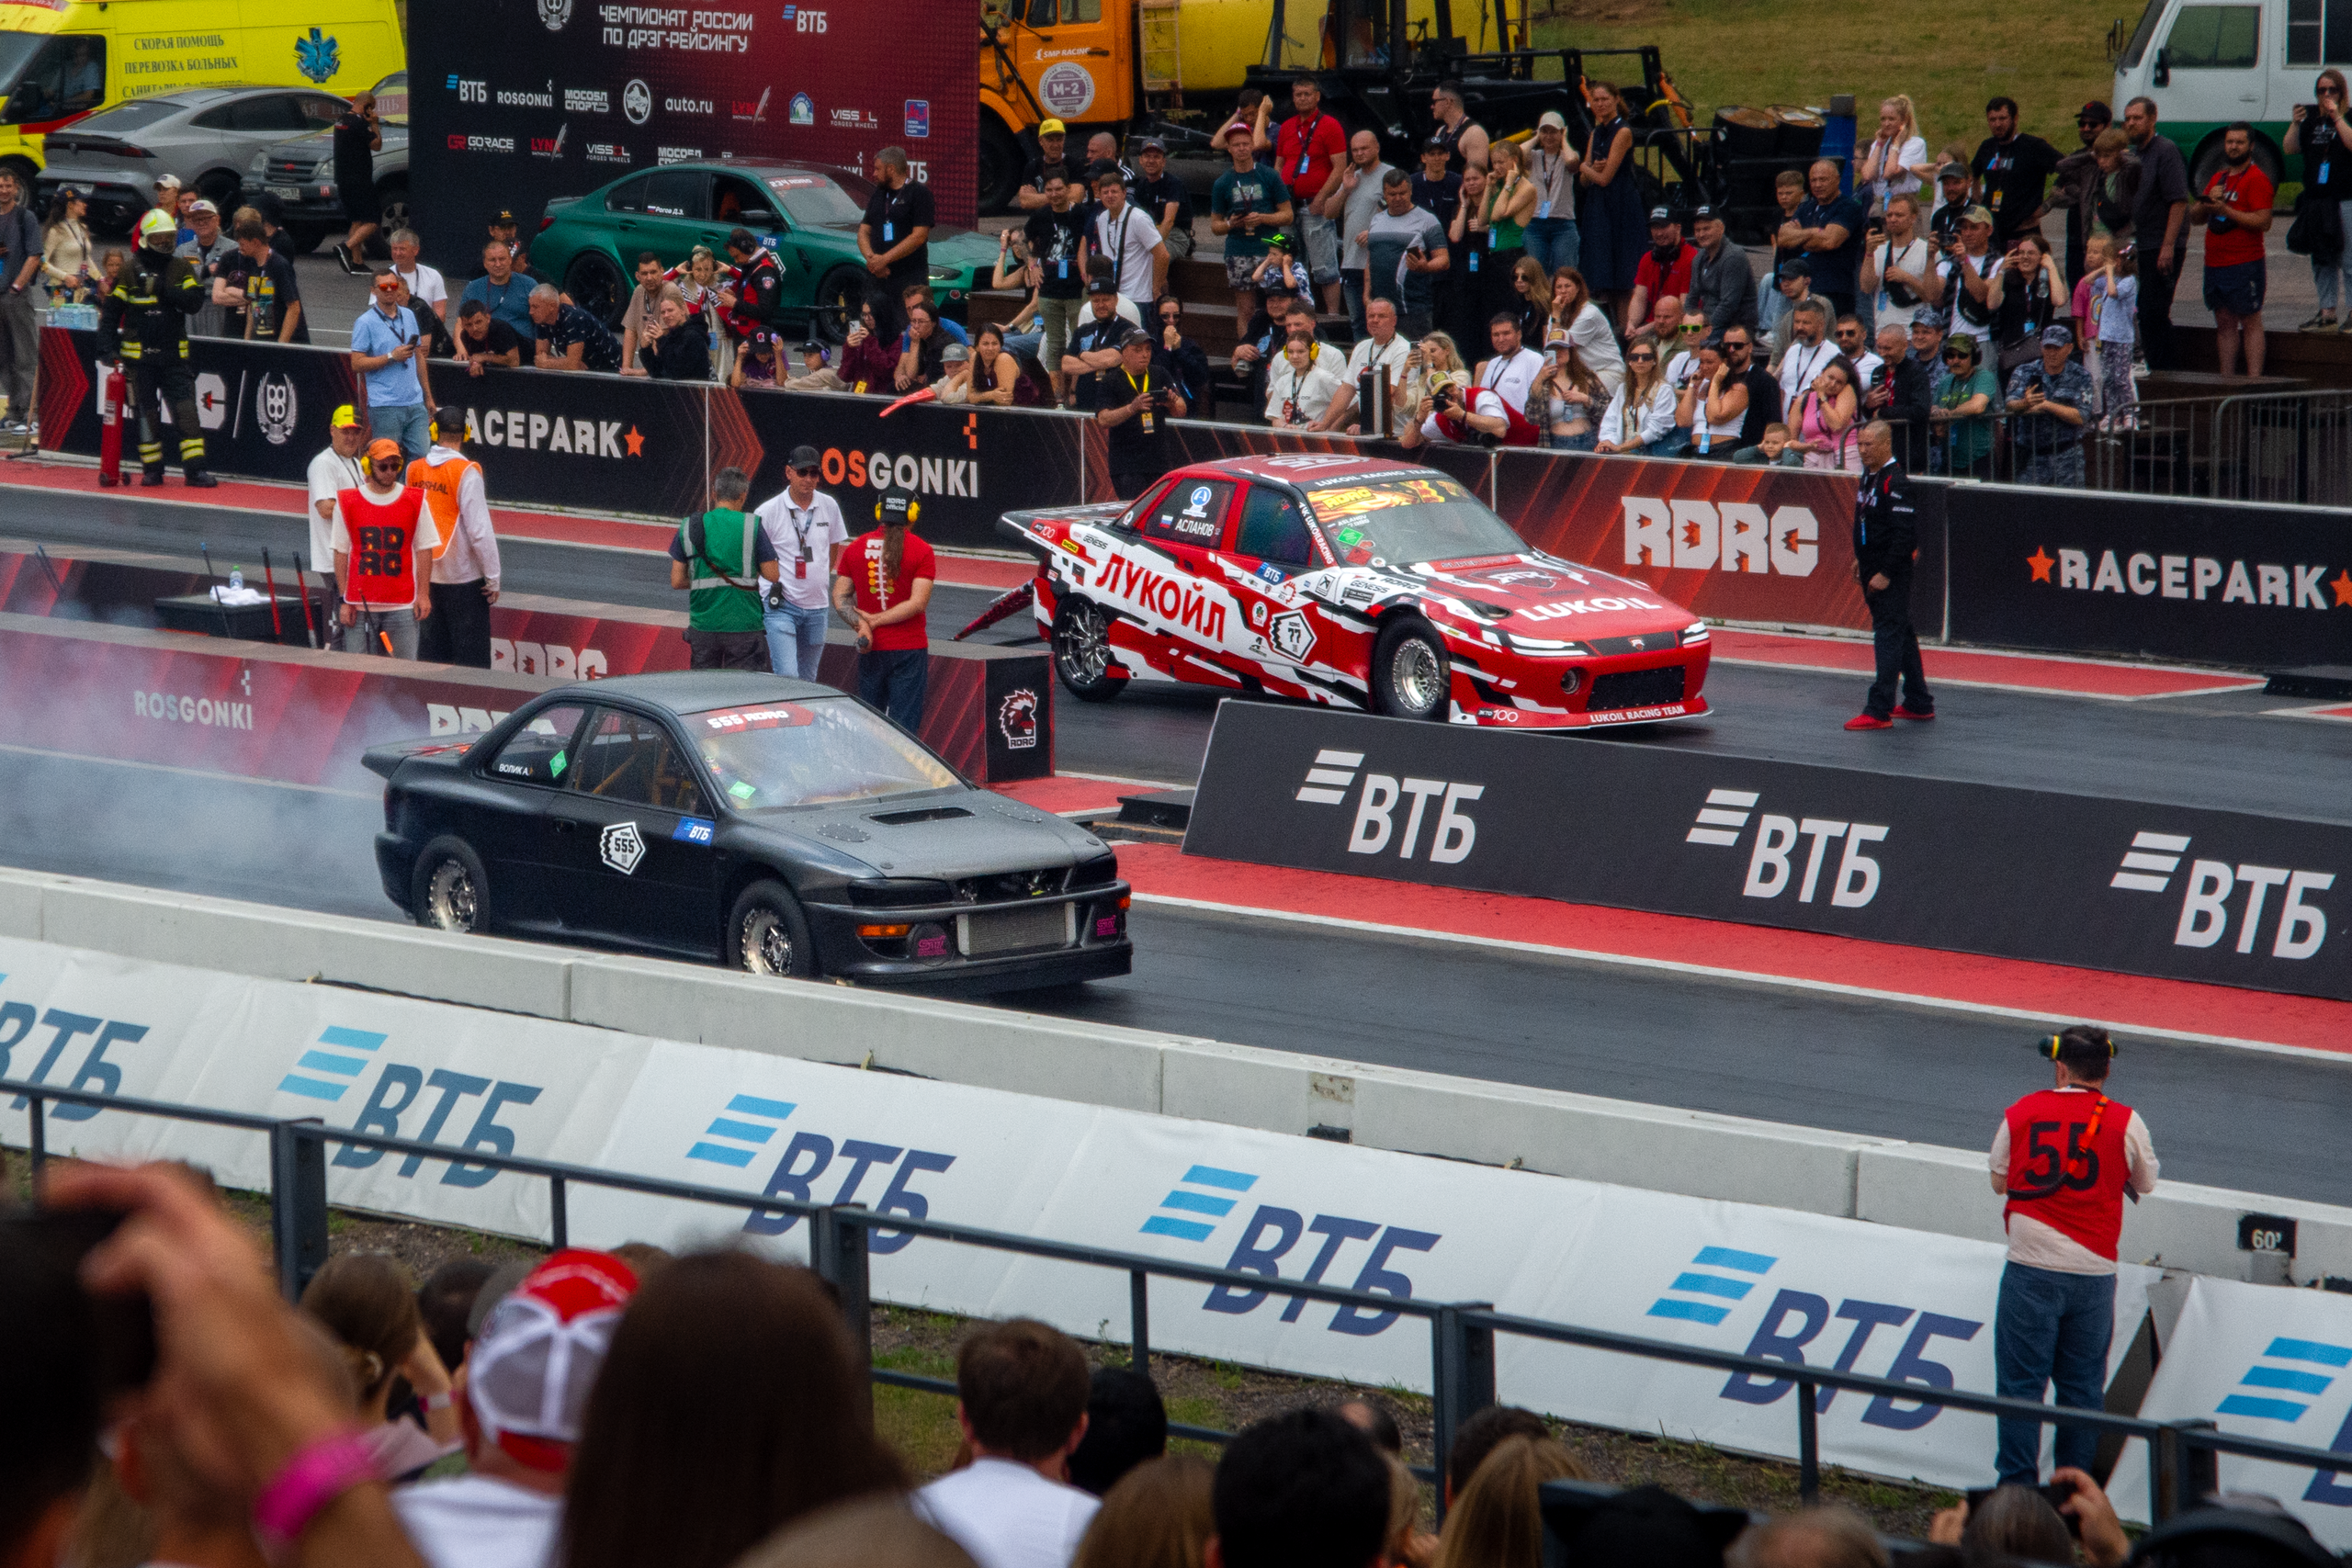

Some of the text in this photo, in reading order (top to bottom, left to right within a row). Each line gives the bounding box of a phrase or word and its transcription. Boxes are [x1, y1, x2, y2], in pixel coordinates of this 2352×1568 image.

[599, 6, 753, 30] ЧЕМПИОНАТ РОССИИ
[797, 10, 827, 33] ВТБ
[133, 34, 225, 51] СКОРАЯ ПОМОЩЬ
[604, 28, 748, 52] ПО ДРЭГ-РЕЙСИНГУ
[1043, 50, 1061, 58] SMP
[124, 56, 238, 74] ПЕРЕВОЗКА БОЛЬНЫХ
[459, 79, 487, 102] ВТБ
[497, 91, 552, 107] ROSGONKI
[1052, 82, 1080, 96] M-2
[665, 96, 713, 114] auto.ru
[830, 108, 878, 122] VISSOL
[586, 143, 630, 156] VISSOL
[907, 160, 928, 184] ТБ
[763, 237, 776, 247] ВТБ
[436, 406, 622, 458] ACEPARK
[821, 447, 978, 498] OSGONKI
[1315, 476, 1361, 488] LUKOIL
[1175, 518, 1215, 536] АСЛАНОВ
[1622, 496, 1818, 577] RDRC
[1082, 535, 1109, 550] GENESIS
[1263, 566, 1282, 583] ВТБ
[2059, 547, 2328, 610] RACEPARK
[1095, 552, 1227, 643] ЛУКОЙЛ
[1350, 580, 1390, 594] GENESIS
[1514, 596, 1664, 622] LUKOIL
[1287, 627, 1302, 644] 77
[134, 690, 254, 730] ROSGONKI
[1492, 708, 1520, 724] 100
[1589, 705, 1687, 724] LUKOIL RACING TEAM
[707, 714, 744, 729] 555
[1348, 773, 1486, 864] ВТБ
[688, 825, 712, 841] ВТБ
[614, 837, 635, 854] 555
[1743, 814, 1890, 908] ВТБ
[2174, 859, 2336, 960] ВТБ
[332, 1063, 544, 1189] ВТБ
[2024, 1121, 2101, 1192] 55
[741, 1131, 957, 1255] ВТБ
[1202, 1204, 1443, 1336] ВТБ
[1719, 1287, 1985, 1432] ВТБ
